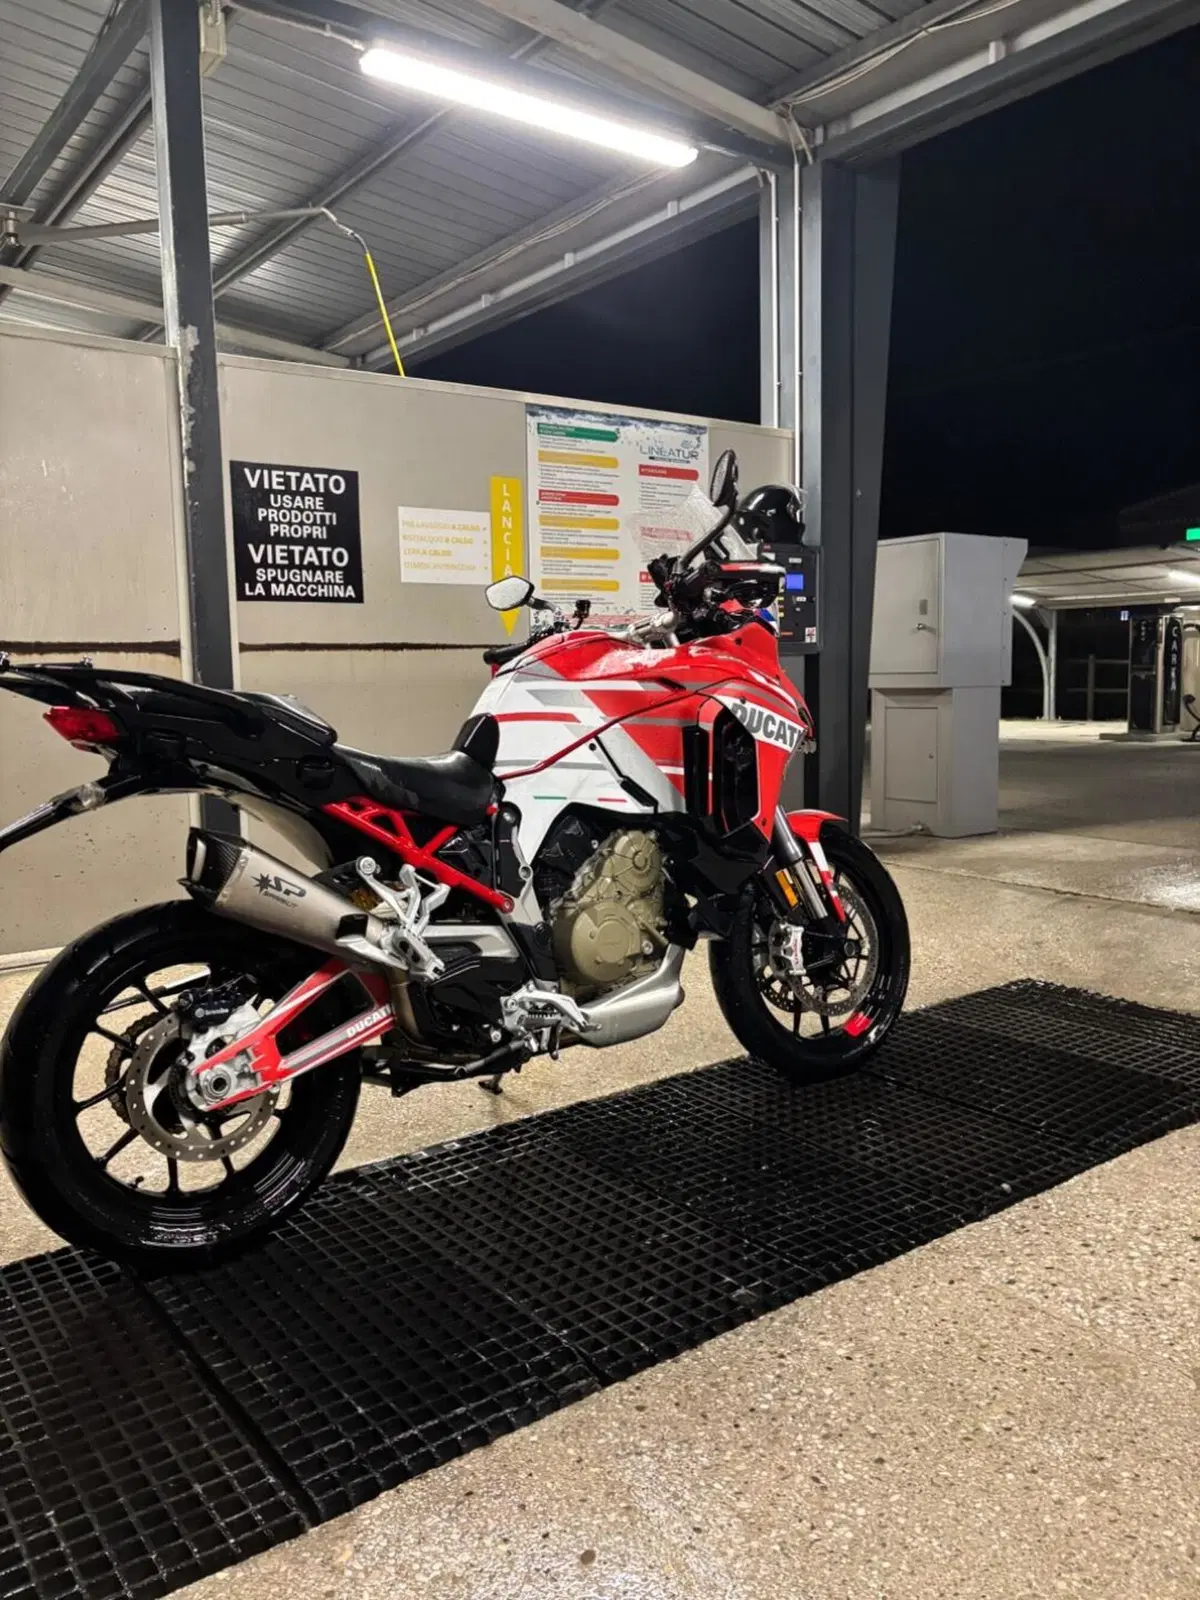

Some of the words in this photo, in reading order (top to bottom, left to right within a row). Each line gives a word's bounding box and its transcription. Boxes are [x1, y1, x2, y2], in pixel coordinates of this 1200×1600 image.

[639, 444, 699, 460] LINEATUR
[244, 468, 346, 495] VIETATO
[270, 494, 325, 510] USARE
[258, 508, 337, 526] PRODOTTI
[270, 524, 327, 540] PROPRI
[502, 483, 513, 578] LANCIA
[248, 544, 349, 568] VIETATO
[256, 568, 344, 584] SPUGNARE
[245, 583, 266, 597] LA
[271, 584, 356, 599] MACCHINA
[346, 1003, 392, 1038] DUCATI
